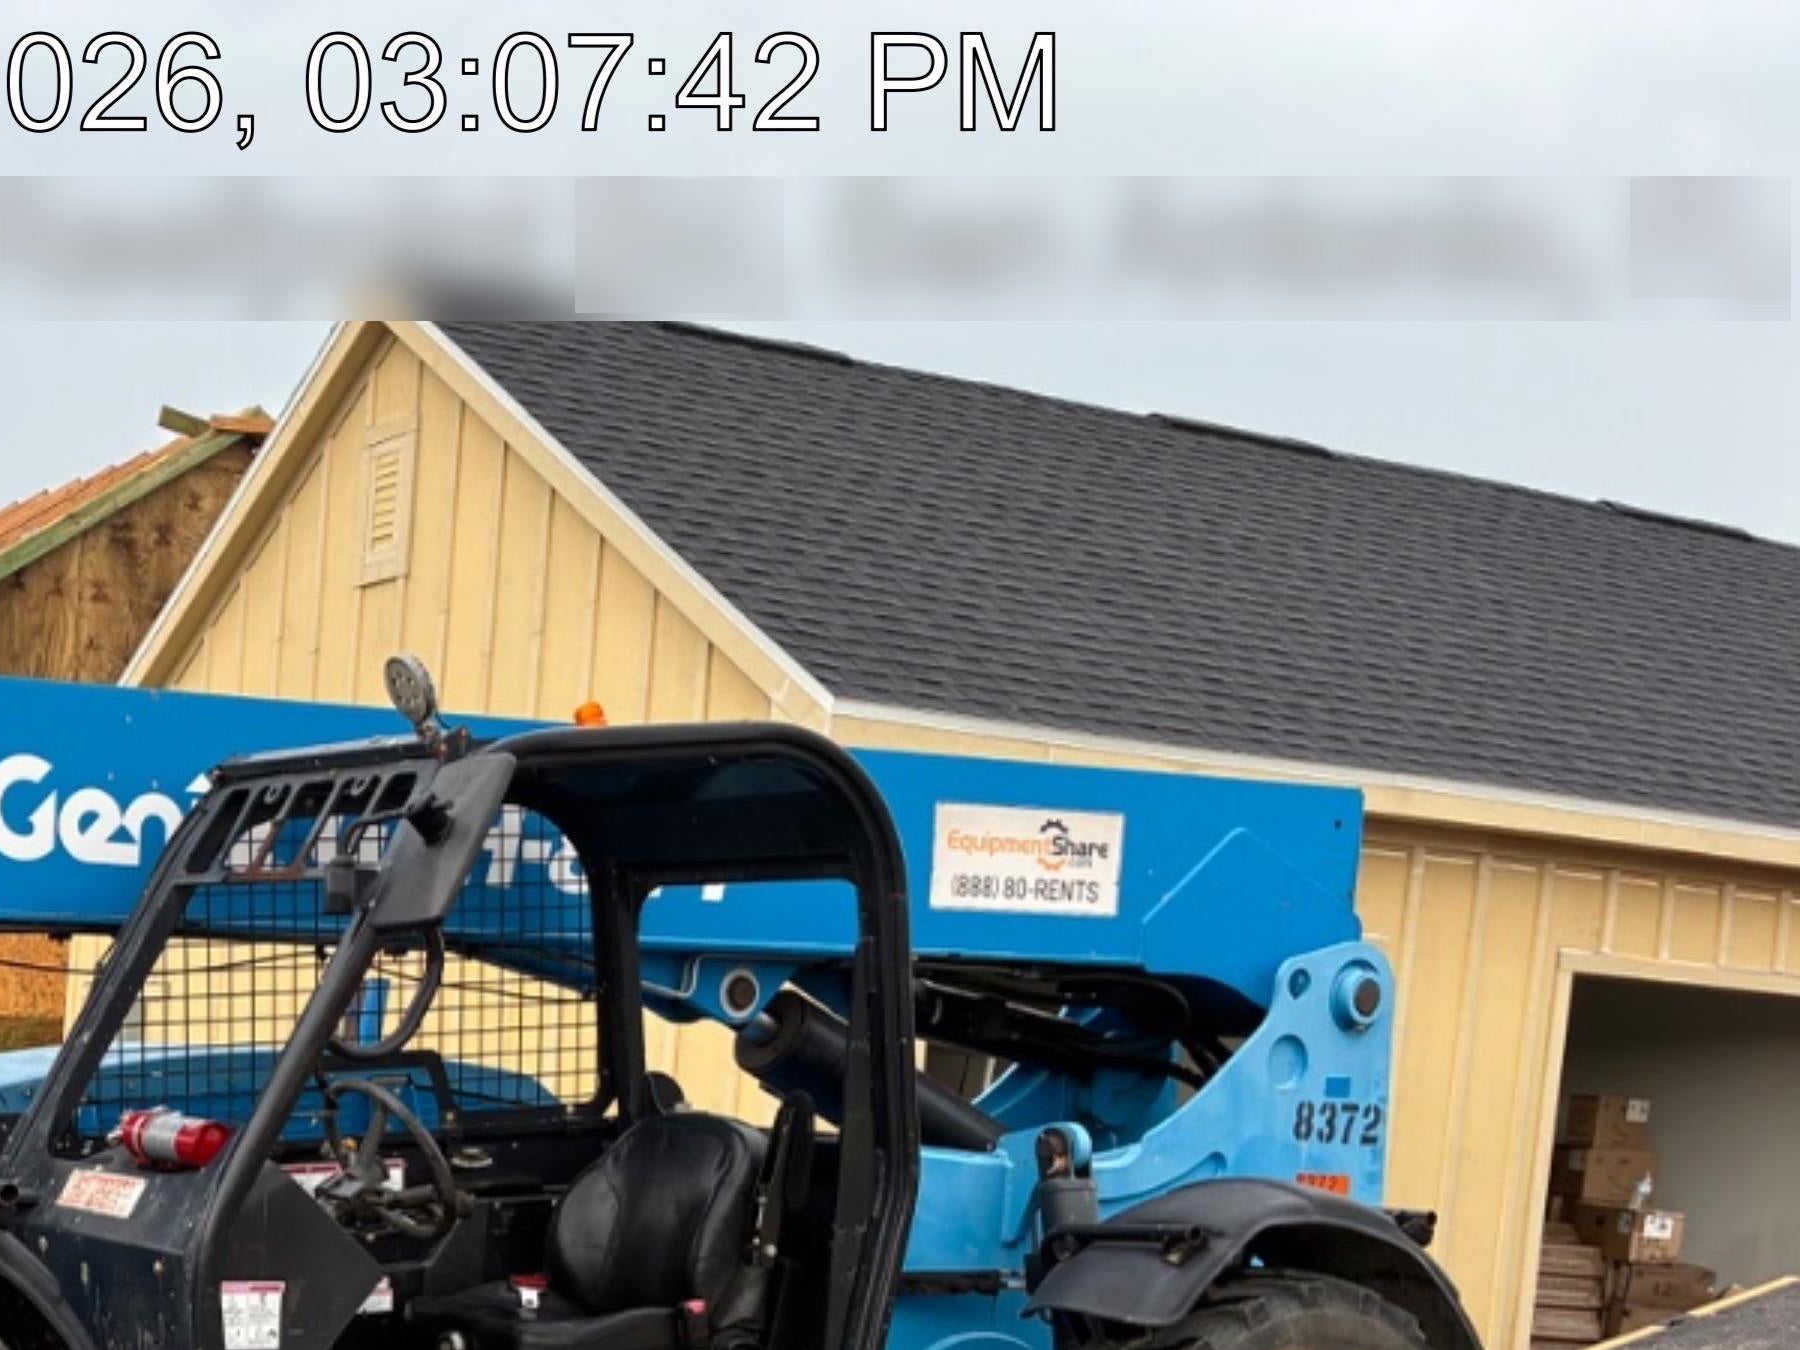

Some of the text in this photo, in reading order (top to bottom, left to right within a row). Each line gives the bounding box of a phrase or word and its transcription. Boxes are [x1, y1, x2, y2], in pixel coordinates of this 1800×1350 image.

[951, 873, 1100, 904] (888) 80-RENTS
[1293, 1100, 1381, 1146] 8372
